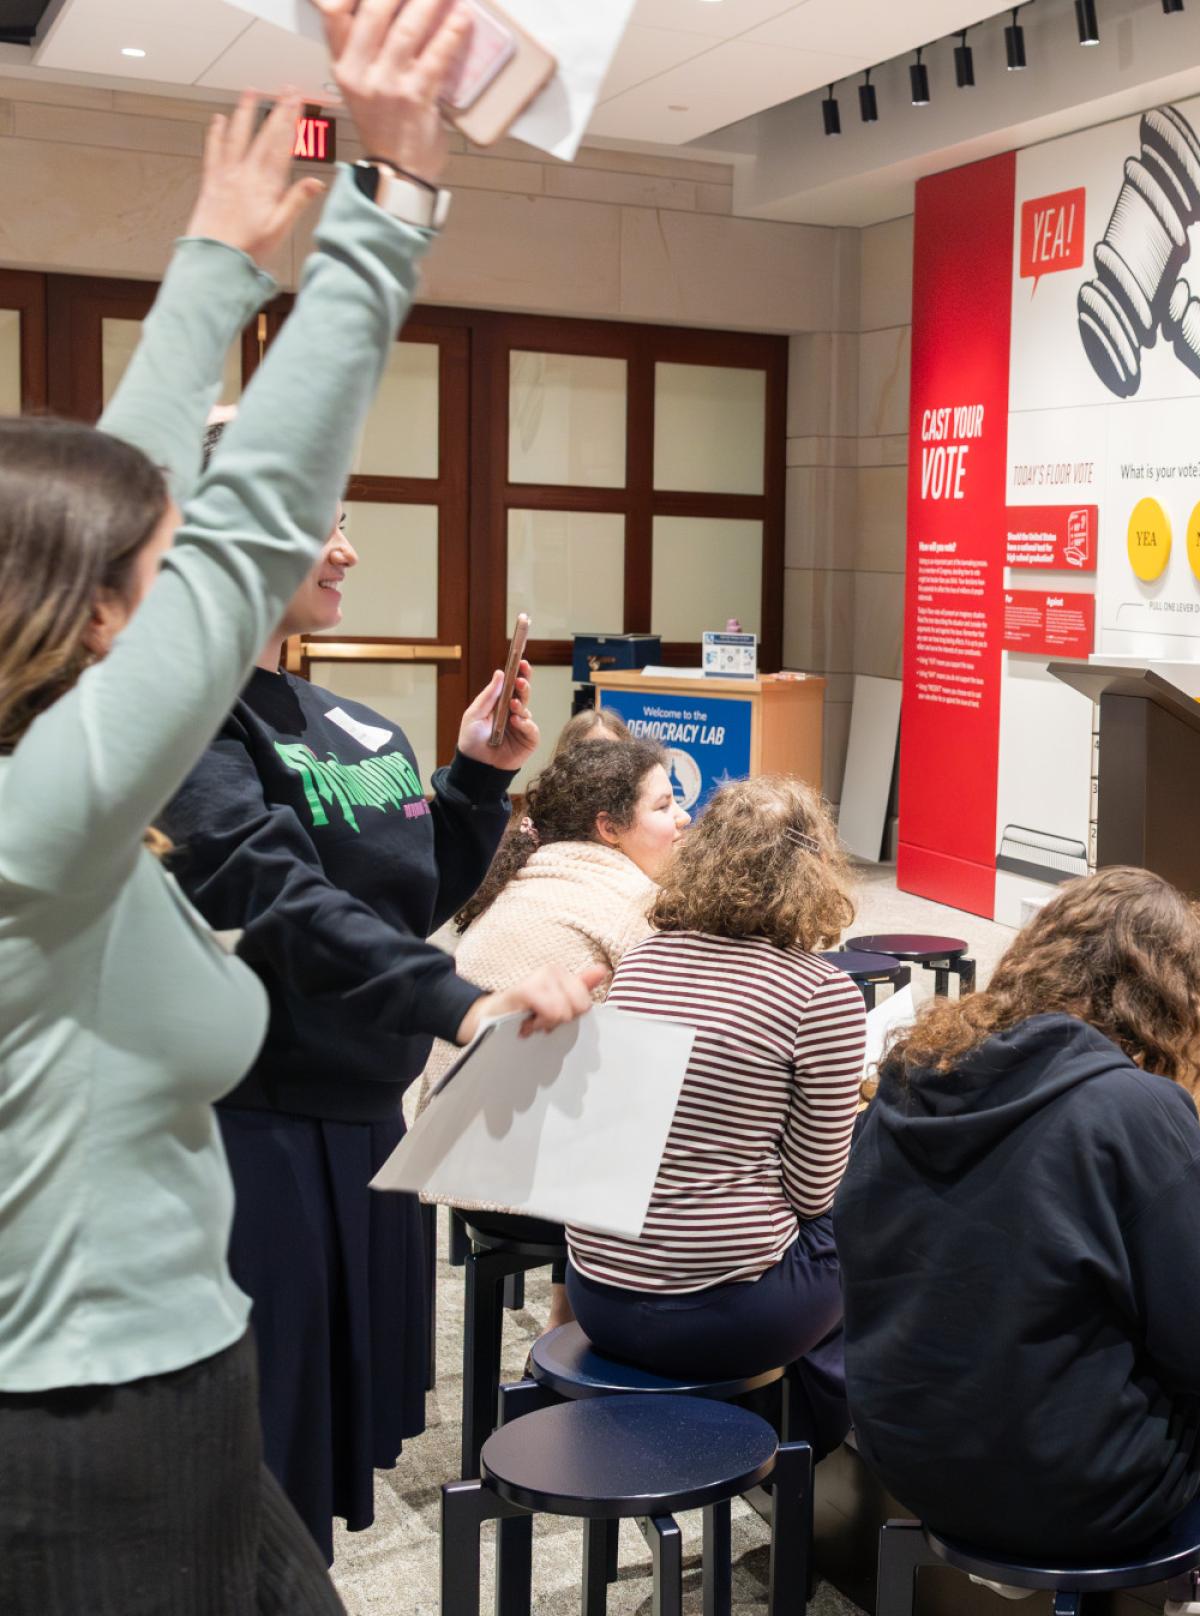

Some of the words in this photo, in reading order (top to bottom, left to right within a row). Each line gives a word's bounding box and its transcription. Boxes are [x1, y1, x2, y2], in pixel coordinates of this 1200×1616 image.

[290, 119, 329, 159] XIT
[1031, 203, 1076, 264] YEA!
[922, 408, 953, 442] CAST
[953, 404, 984, 439] YOUR
[921, 445, 969, 500] VOTE
[1013, 463, 1045, 486] TODAY'S
[1045, 463, 1073, 485] FLOOR
[1073, 462, 1095, 484] VOTE
[1120, 463, 1144, 479] What
[1146, 464, 1154, 479] is
[1155, 466, 1176, 481] your
[1136, 531, 1157, 547] YEA
[1149, 600, 1162, 611] PULL
[1163, 602, 1175, 612] ONE
[1176, 602, 1194, 613] LEVER
[643, 706, 682, 719] Welcome
[683, 710, 692, 720] to
[693, 710, 707, 721] the
[627, 719, 700, 743] DEMOCRACY
[700, 725, 725, 745] LAB
